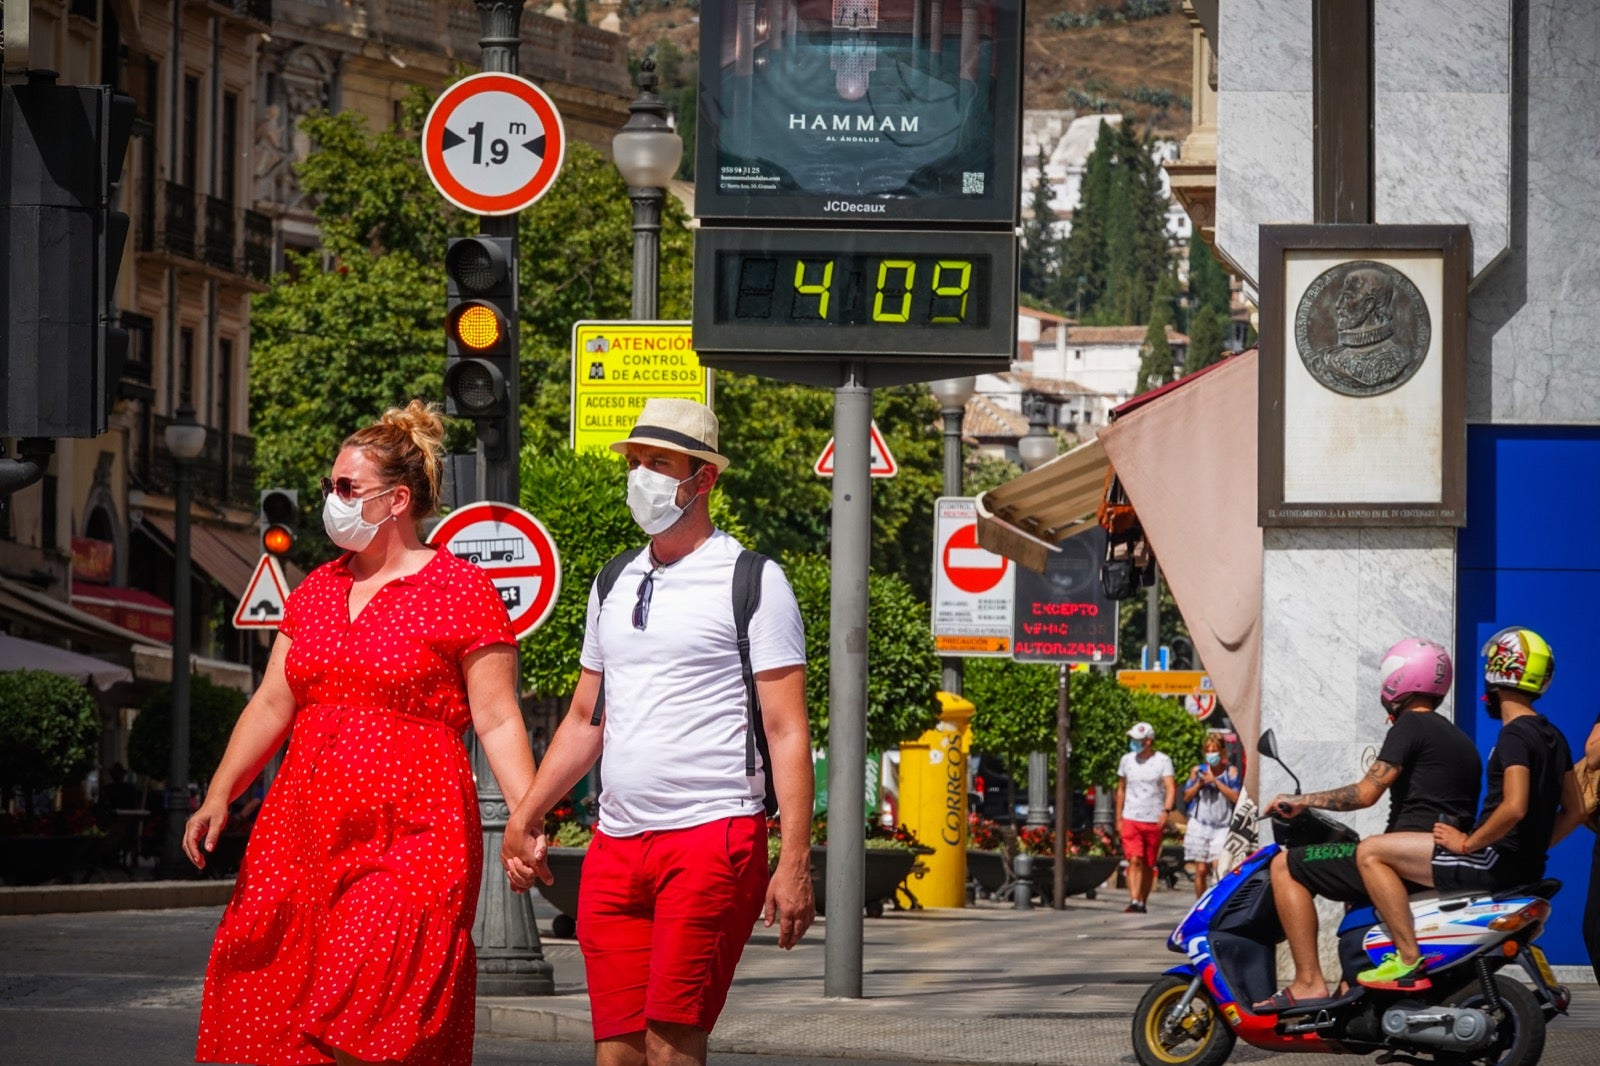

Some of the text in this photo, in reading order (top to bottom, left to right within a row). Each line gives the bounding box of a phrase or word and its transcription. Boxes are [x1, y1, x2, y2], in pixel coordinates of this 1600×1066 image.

[789, 113, 919, 132] HAMMAM
[468, 121, 527, 168] 1,9 m
[823, 201, 886, 213] JCDecaux
[622, 354, 687, 366] CONTROL
[612, 369, 698, 381] DE ACCESOS
[586, 396, 625, 408] ACCESO
[585, 415, 614, 427] CALLE
[1031, 601, 1099, 616] EXCEPTO
